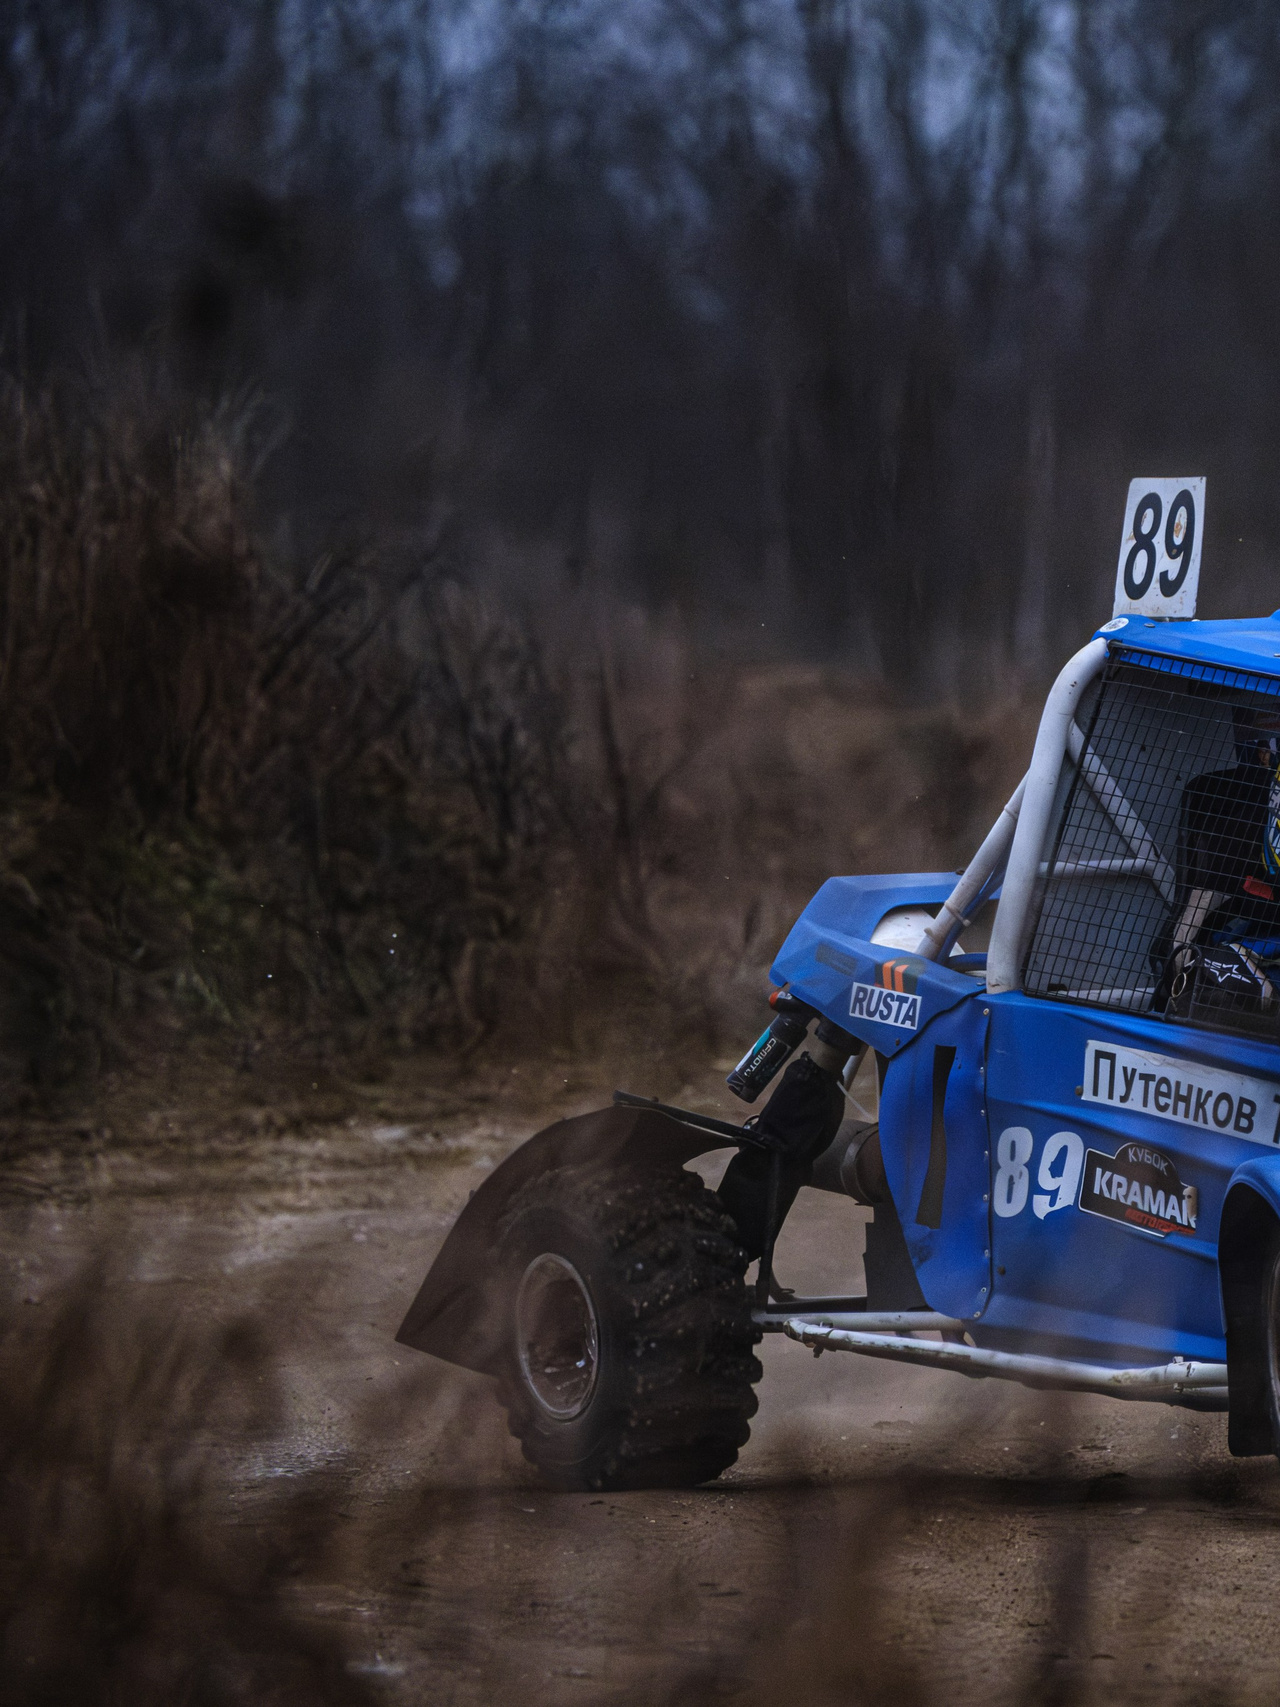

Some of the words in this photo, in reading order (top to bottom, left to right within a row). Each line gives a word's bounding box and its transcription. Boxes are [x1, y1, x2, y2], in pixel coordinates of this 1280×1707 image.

[1123, 488, 1196, 600] 89
[851, 985, 921, 1028] RUSTA
[744, 1037, 777, 1077] CFMOTO
[1092, 1048, 1257, 1135] Путенков
[993, 1126, 1085, 1220] 89
[1128, 1147, 1168, 1176] КУБОК
